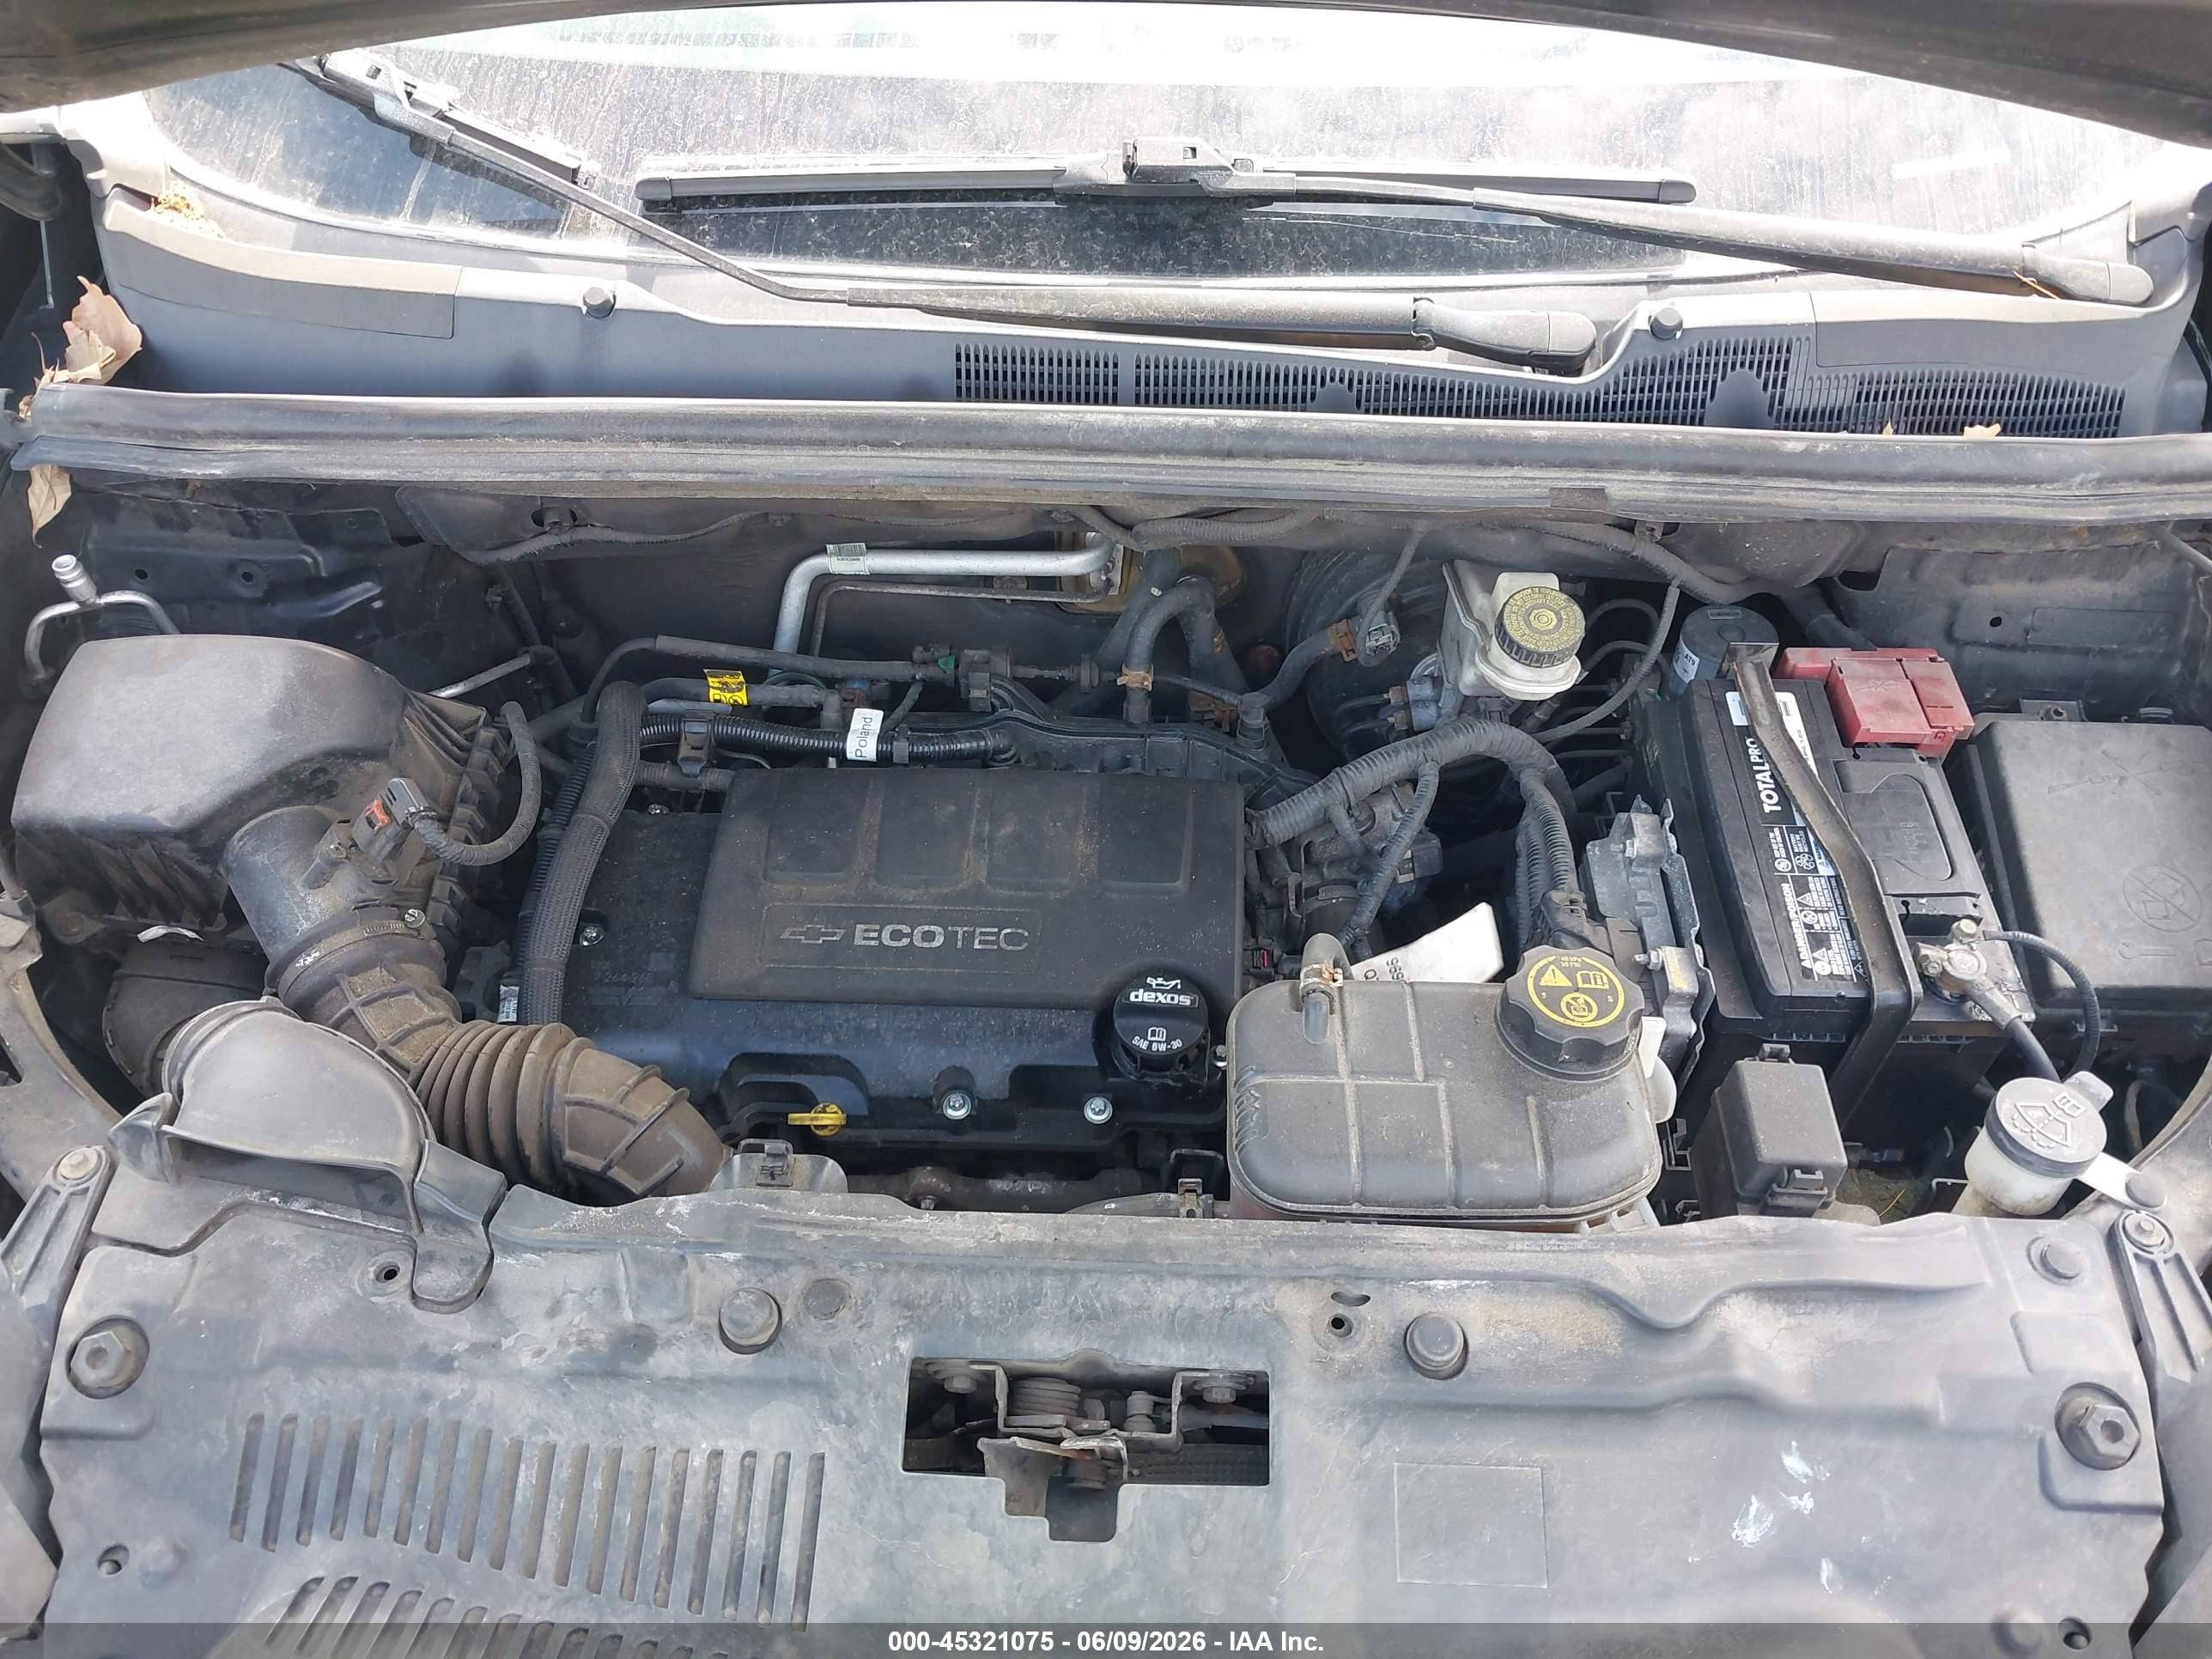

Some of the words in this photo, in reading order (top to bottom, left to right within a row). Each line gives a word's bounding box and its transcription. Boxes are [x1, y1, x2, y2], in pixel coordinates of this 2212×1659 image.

[854, 716, 873, 758] Poland
[853, 924, 1030, 951] ECOTEC
[1129, 988, 1191, 1006] dexos
[1132, 1036, 1150, 1050] SAE
[1152, 1039, 1182, 1052] 5W-30
